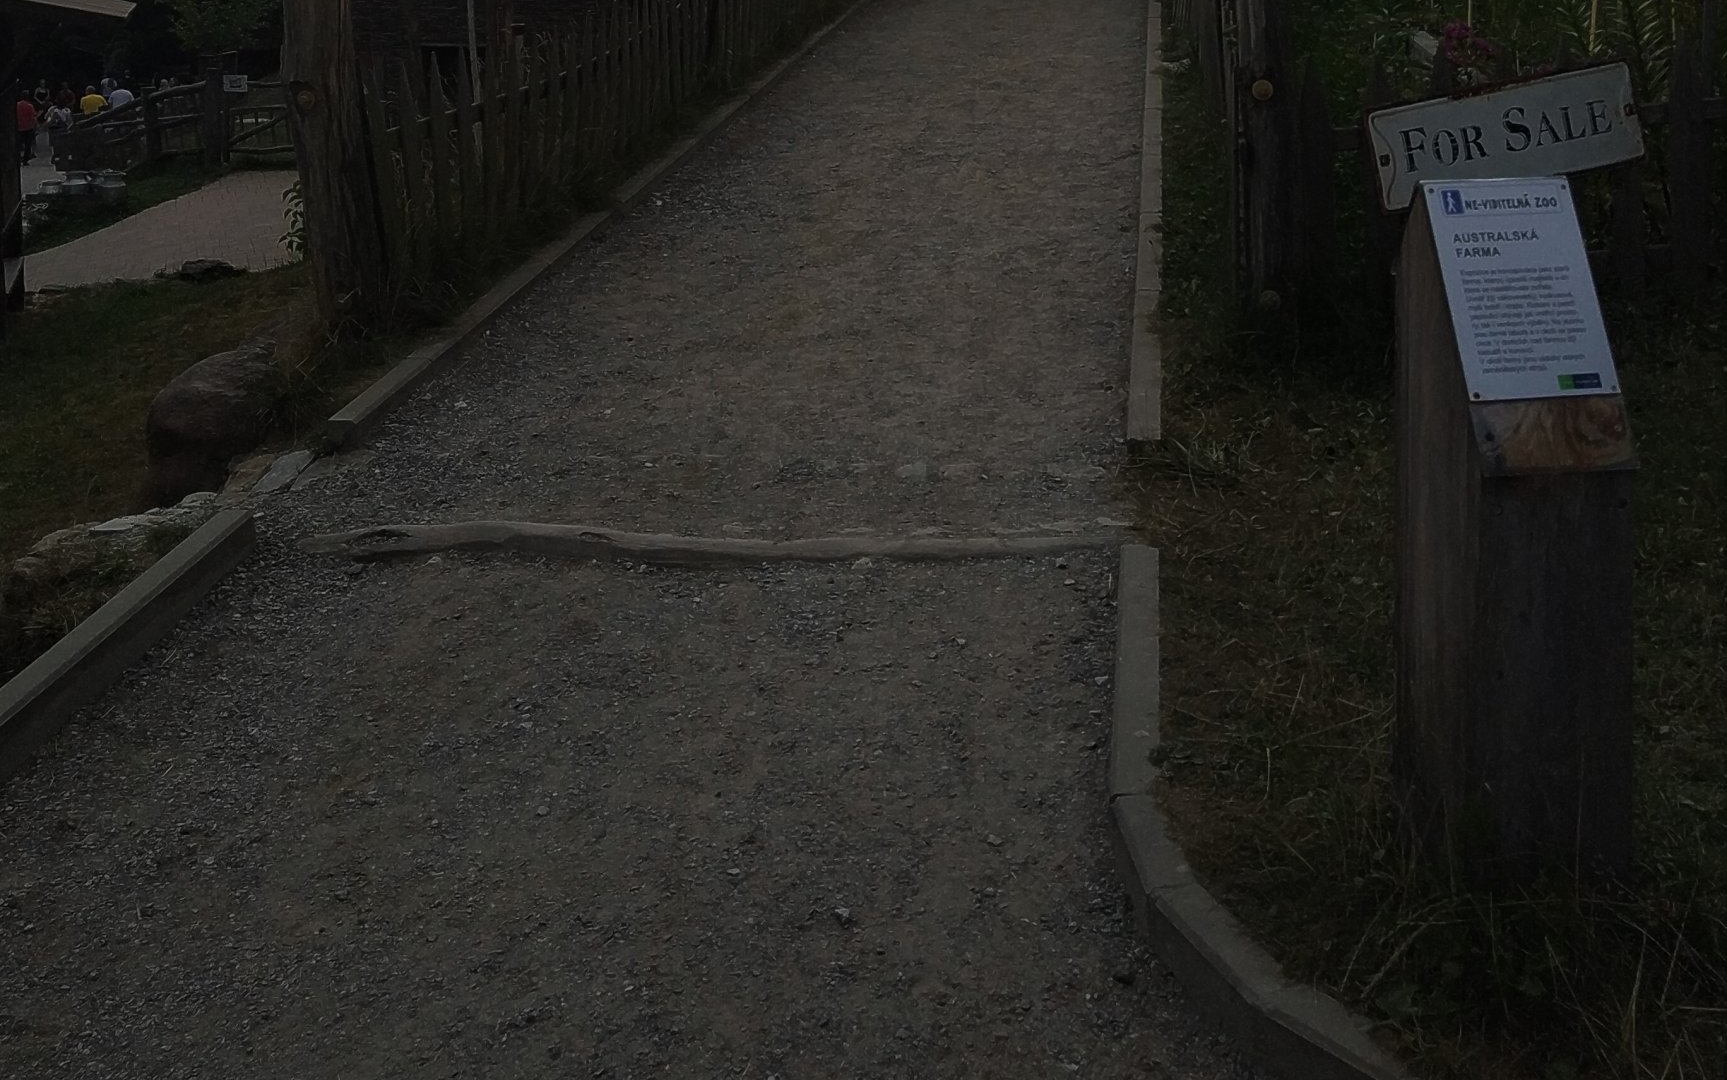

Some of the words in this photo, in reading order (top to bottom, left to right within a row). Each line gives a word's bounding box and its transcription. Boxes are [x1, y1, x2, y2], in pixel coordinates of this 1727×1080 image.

[1399, 126, 1489, 173] FOR
[1502, 100, 1613, 153] SALE
[1464, 193, 1531, 211] NE-VIDITELNÁ
[1533, 196, 1558, 209] ZOO
[1452, 228, 1540, 244] AUSTRALSKÁ
[1455, 246, 1502, 259] FARMA
